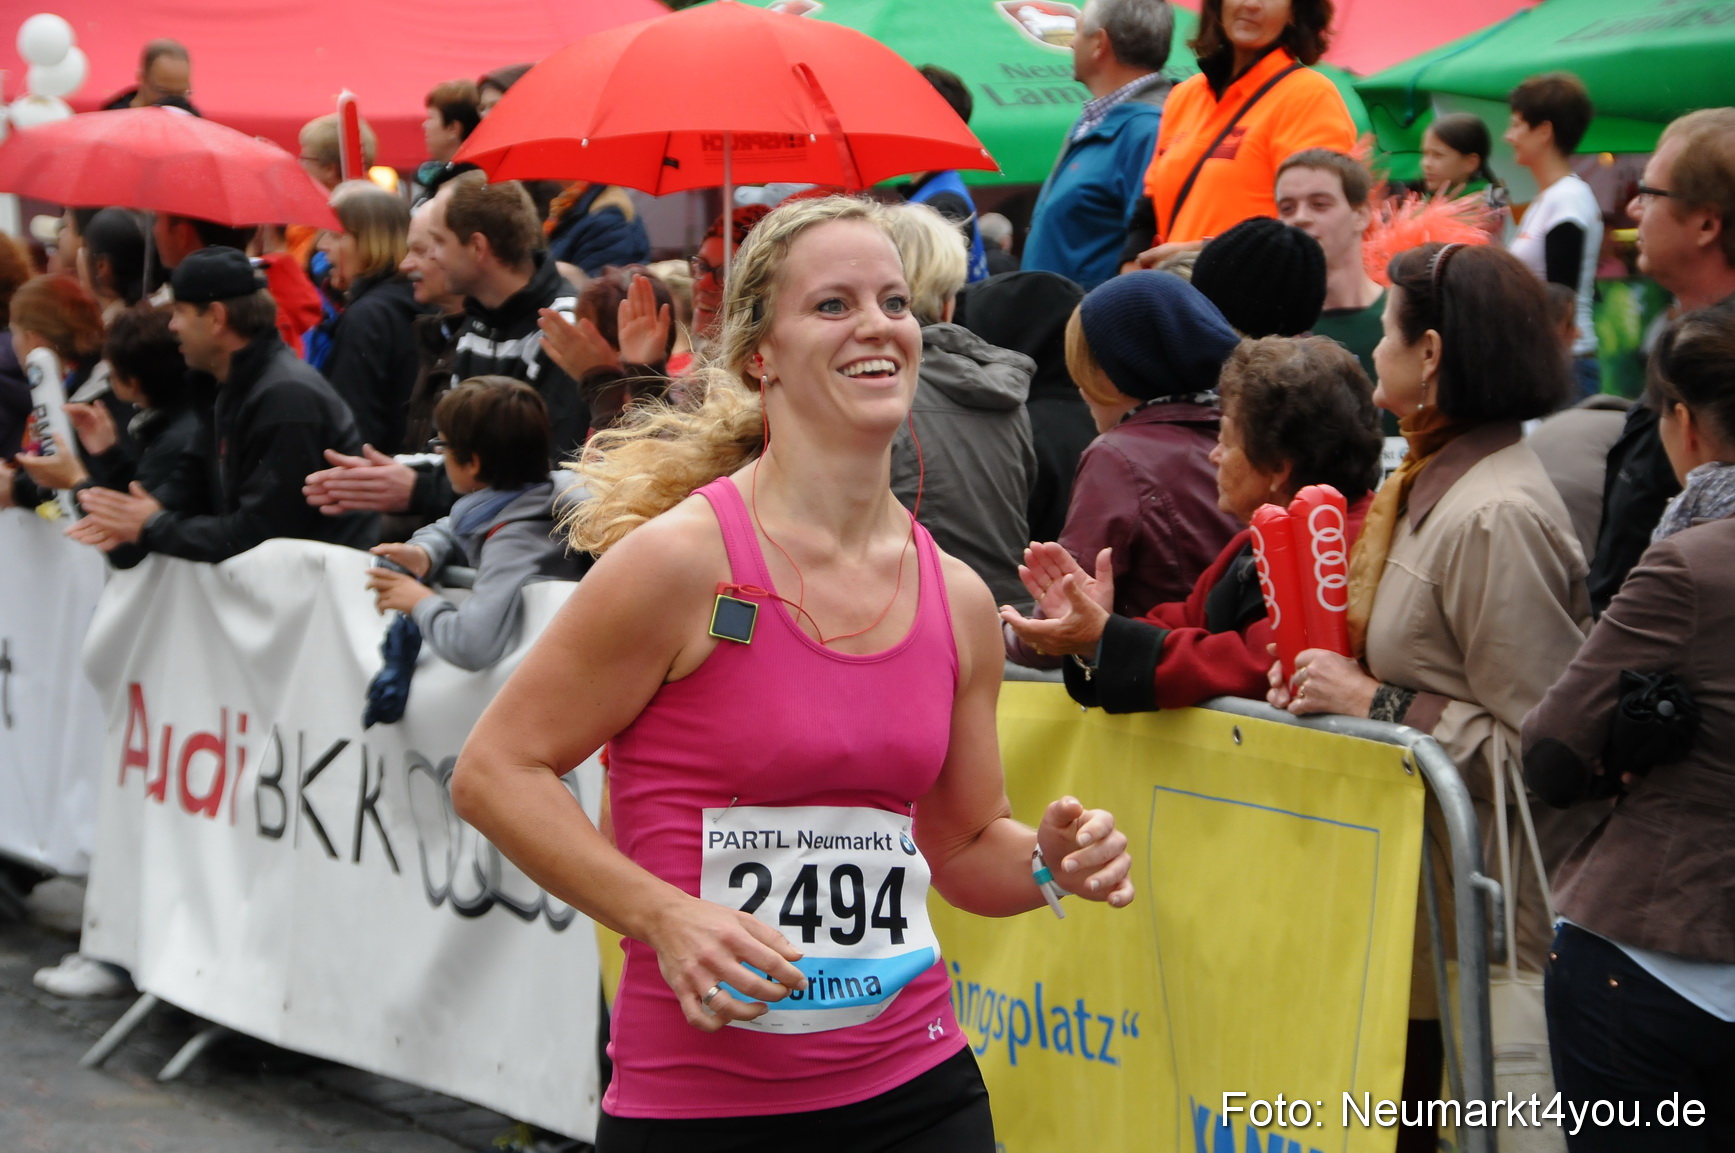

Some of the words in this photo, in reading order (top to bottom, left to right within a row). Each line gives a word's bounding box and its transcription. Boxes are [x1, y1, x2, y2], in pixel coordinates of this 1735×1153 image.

[118, 681, 249, 827] Audi
[254, 723, 402, 876] BKK
[708, 830, 790, 849] PARTL
[797, 831, 893, 850] Neumarkt
[728, 862, 909, 946] 2494
[766, 969, 883, 1001] rinna
